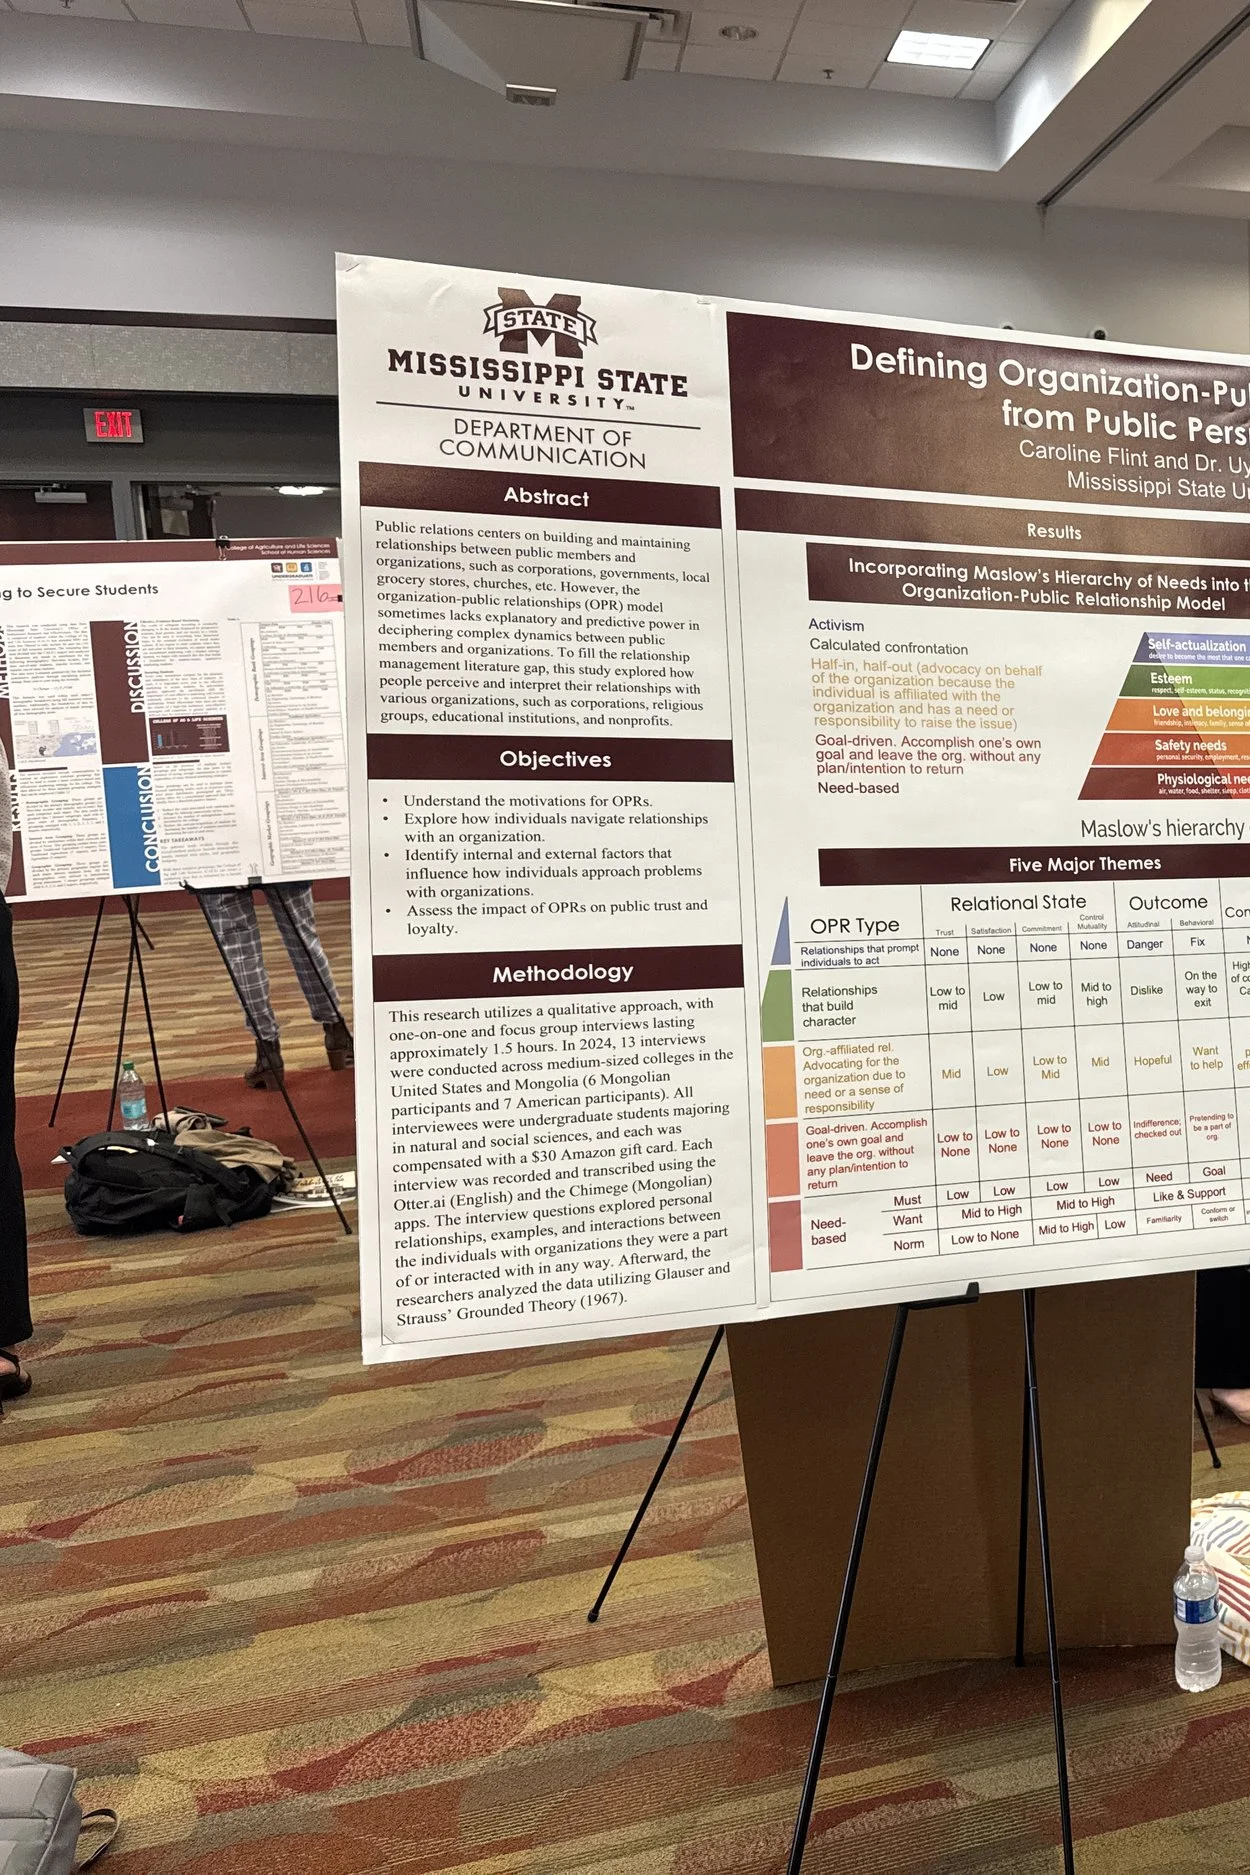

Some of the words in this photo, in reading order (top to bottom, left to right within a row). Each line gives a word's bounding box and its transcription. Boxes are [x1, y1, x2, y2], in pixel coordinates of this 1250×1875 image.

[503, 310, 577, 336] STATE
[388, 348, 584, 387] MISSISSIPPI
[598, 368, 687, 396] STATE
[851, 343, 986, 388] Defining
[94, 411, 133, 438] EXIT
[1002, 398, 1073, 430] from
[1086, 407, 1176, 439] Public
[454, 418, 594, 443] DEPARTMENT
[603, 429, 630, 446] OF
[439, 439, 645, 469] COMMUNICATION
[1019, 439, 1100, 462] Caroline
[1108, 447, 1148, 466] Flint
[1154, 453, 1188, 469] and
[1195, 453, 1221, 471] Dr.
[1068, 470, 1170, 498] Mississippi
[1178, 478, 1225, 497] State
[504, 487, 588, 506] Abstract
[1027, 523, 1081, 539] Results
[255, 543, 284, 551] Agriculture
[849, 558, 967, 581] Incorporating
[1055, 570, 1132, 589] Hierarchy
[1137, 574, 1152, 587] of
[1157, 575, 1207, 589] Needs
[1211, 576, 1239, 591] into
[17, 586, 33, 598] to
[37, 586, 91, 598] Secure
[95, 583, 159, 596] Students
[291, 585, 329, 605] 216
[902, 582, 1069, 604] Organization-Public
[1076, 592, 1171, 611] Relationship
[1176, 596, 1224, 610] Model
[808, 618, 864, 631] Activism
[809, 637, 879, 651] Calculated
[884, 642, 967, 654] confrontation
[1148, 638, 1246, 652] Self-actualization
[123, 620, 145, 713] DISCUSSION
[1150, 672, 1192, 684] Esteem
[1152, 705, 1179, 716] Love
[1182, 704, 1203, 717] and
[1155, 738, 1190, 753] Safety
[1193, 739, 1226, 751] needs
[500, 750, 611, 770] Objectives
[818, 781, 898, 793] Need-based
[1157, 772, 1231, 787] Physiological
[404, 795, 480, 806] Understand
[485, 795, 504, 806] the
[509, 795, 585, 806] motivations
[590, 795, 608, 806] for
[612, 795, 652, 806] OPRs.
[137, 766, 160, 873] CONCLUSION
[1081, 819, 1161, 837] Maslow's
[1166, 818, 1244, 840] hierarchy
[1009, 857, 1042, 871] Five
[1048, 856, 1094, 874] Major
[1099, 856, 1160, 869] Themes
[951, 895, 1037, 911] Relational
[1042, 894, 1086, 908] State
[1129, 895, 1207, 910] Outcome
[810, 918, 849, 933] OPR
[855, 918, 899, 935] Type
[1126, 939, 1163, 950] Danger
[1190, 937, 1204, 946] Fix
[493, 964, 633, 982] Methodology
[1134, 1054, 1171, 1067] Hopeful
[456, 1301, 523, 1319] Grounded
[528, 1299, 575, 1311] Theory
[580, 1292, 626, 1309] (1967).
